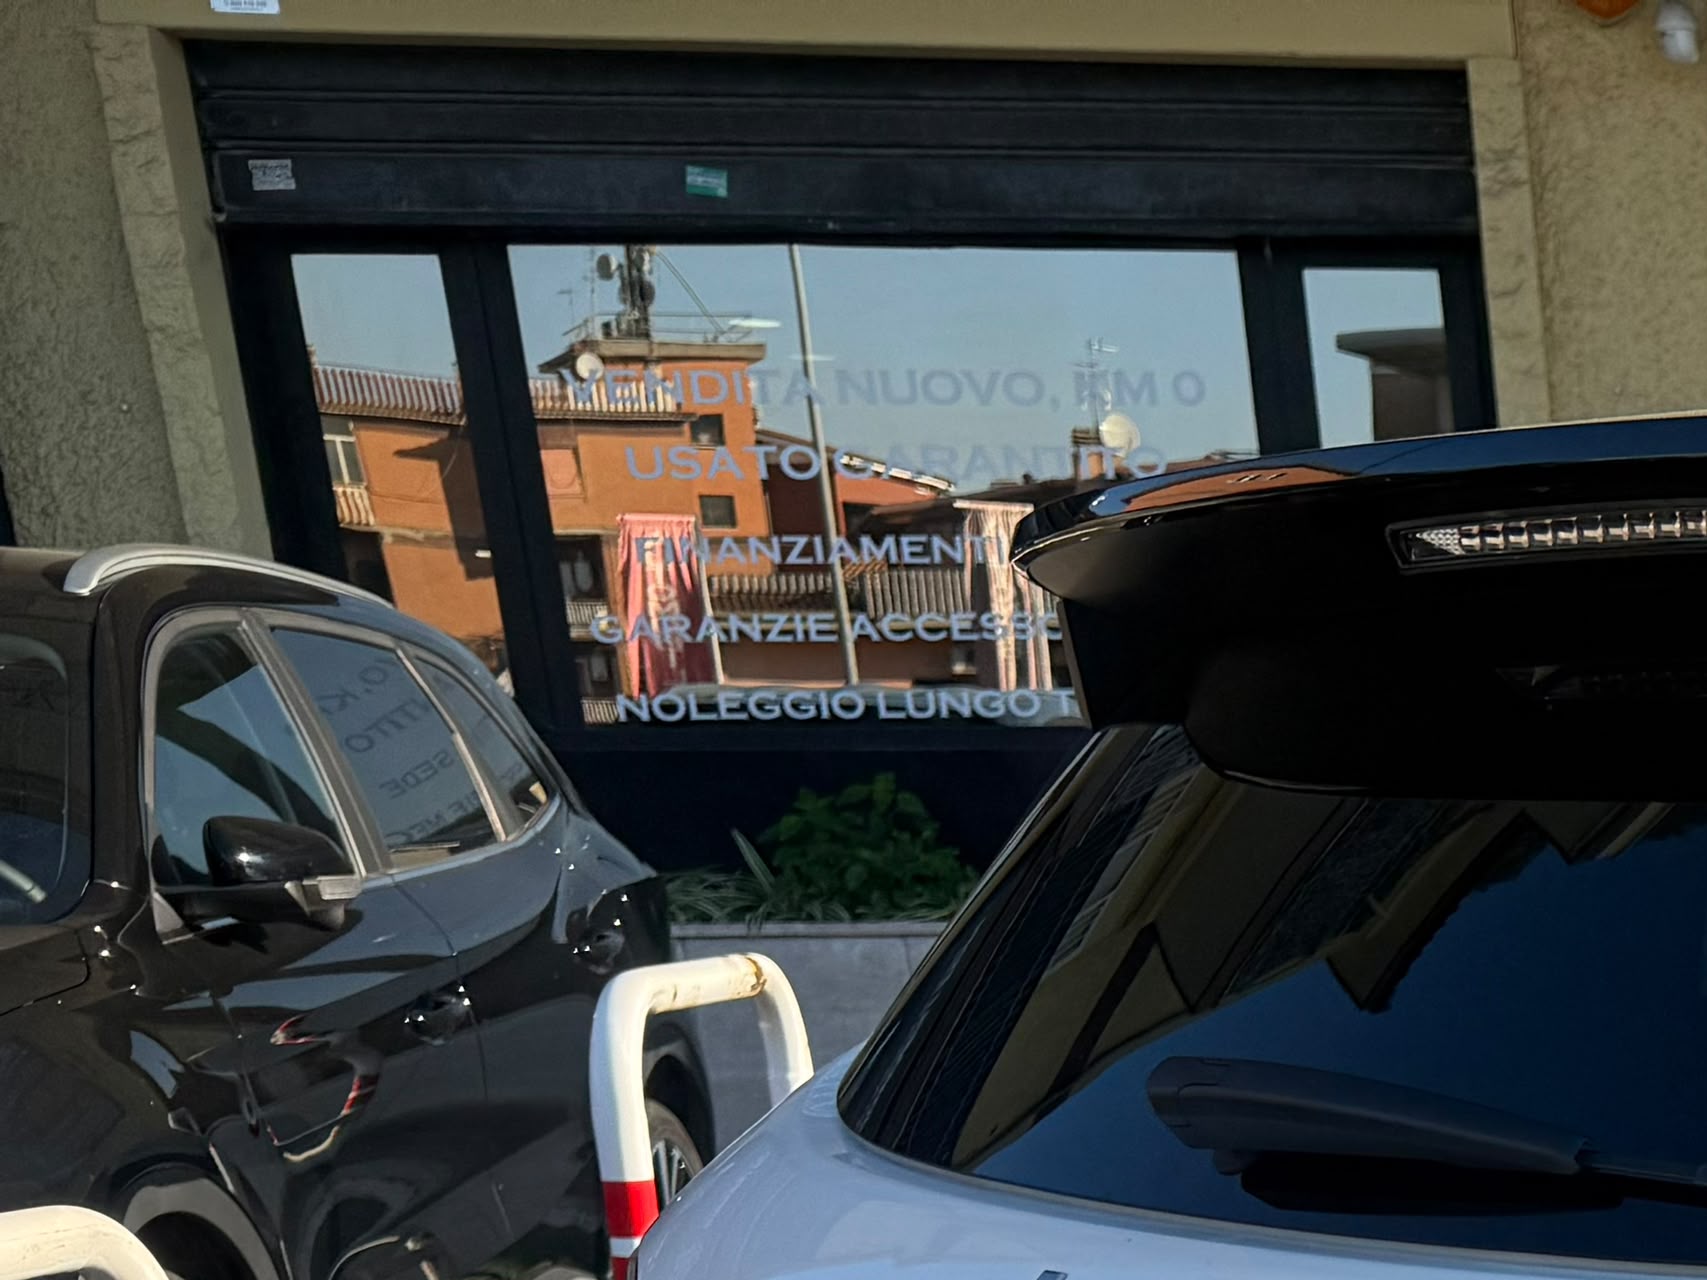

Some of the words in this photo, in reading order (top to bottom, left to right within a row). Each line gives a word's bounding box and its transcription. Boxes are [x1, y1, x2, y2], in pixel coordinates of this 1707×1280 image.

[559, 366, 820, 406] VENDITA
[834, 368, 1061, 412] NUOVO,
[624, 444, 824, 481] USATO
[834, 445, 1167, 482] GARANTITO
[634, 533, 1007, 566] FINANZIAMENTI
[589, 611, 840, 644] GARANZIE
[615, 690, 867, 722] NOLEGGIO
[876, 690, 1041, 719] LUNGO
